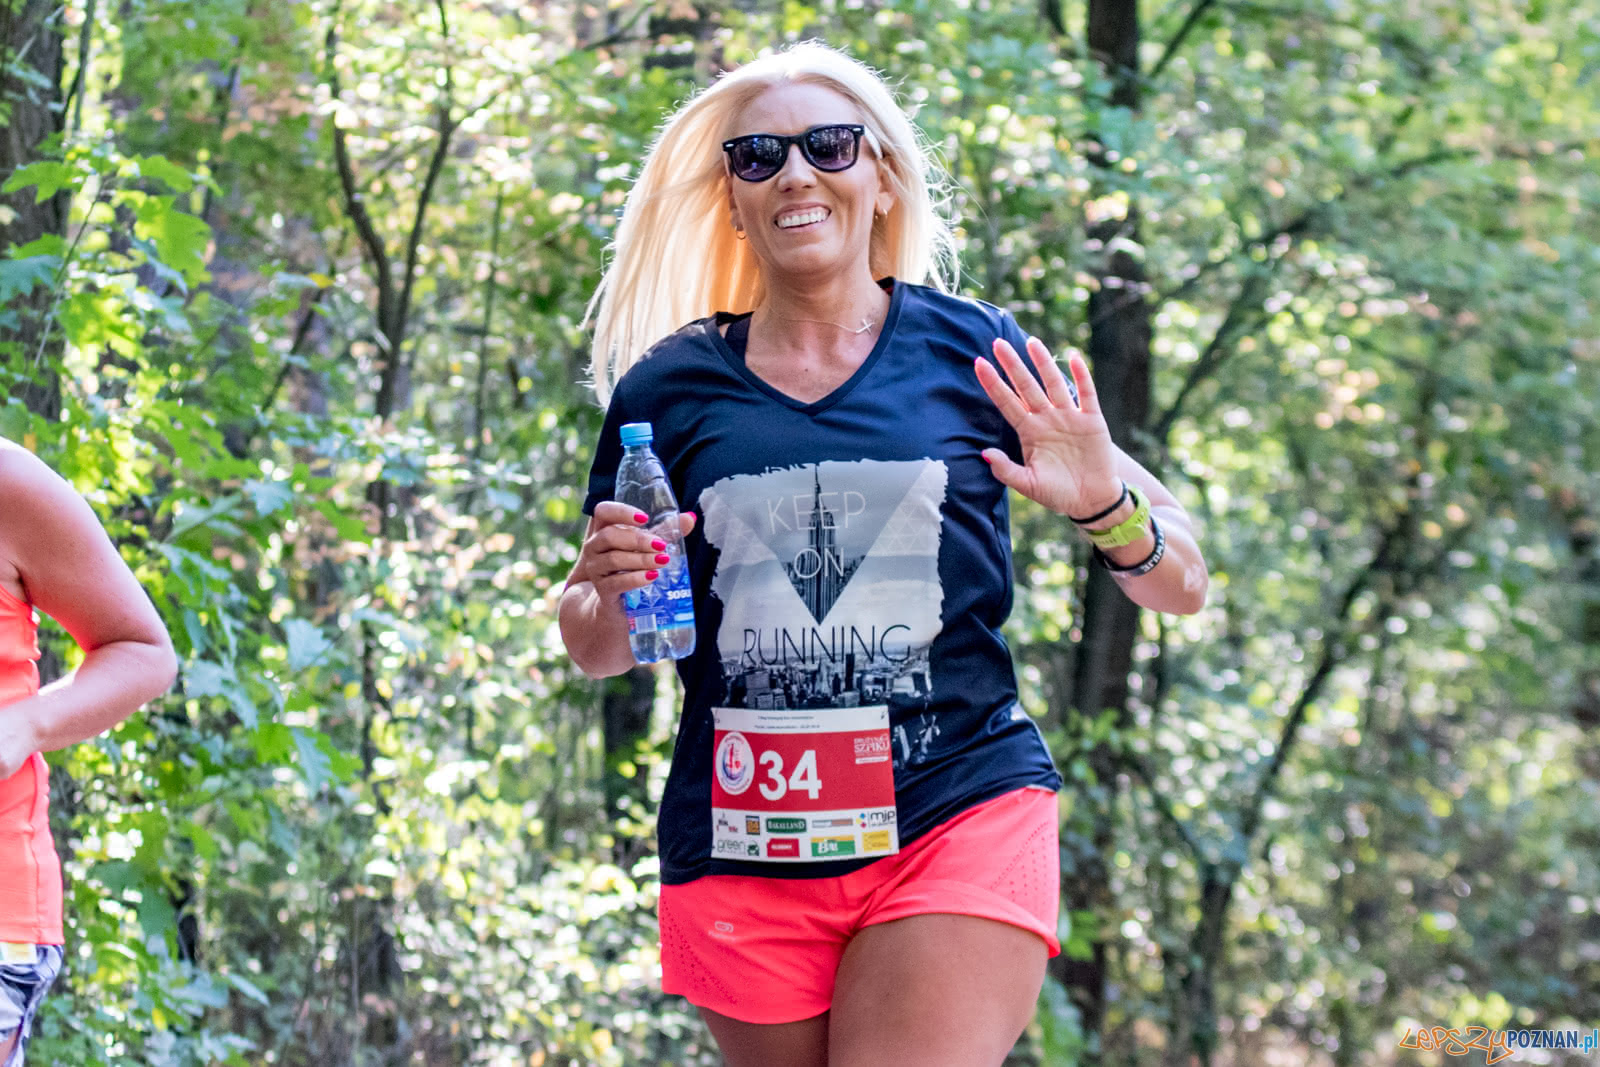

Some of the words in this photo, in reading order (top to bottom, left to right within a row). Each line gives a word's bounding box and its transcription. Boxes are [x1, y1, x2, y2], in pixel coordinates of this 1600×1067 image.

[767, 491, 866, 534] KEEP
[793, 548, 845, 579] ON
[742, 624, 911, 665] RUNNING
[758, 749, 823, 801] 34
